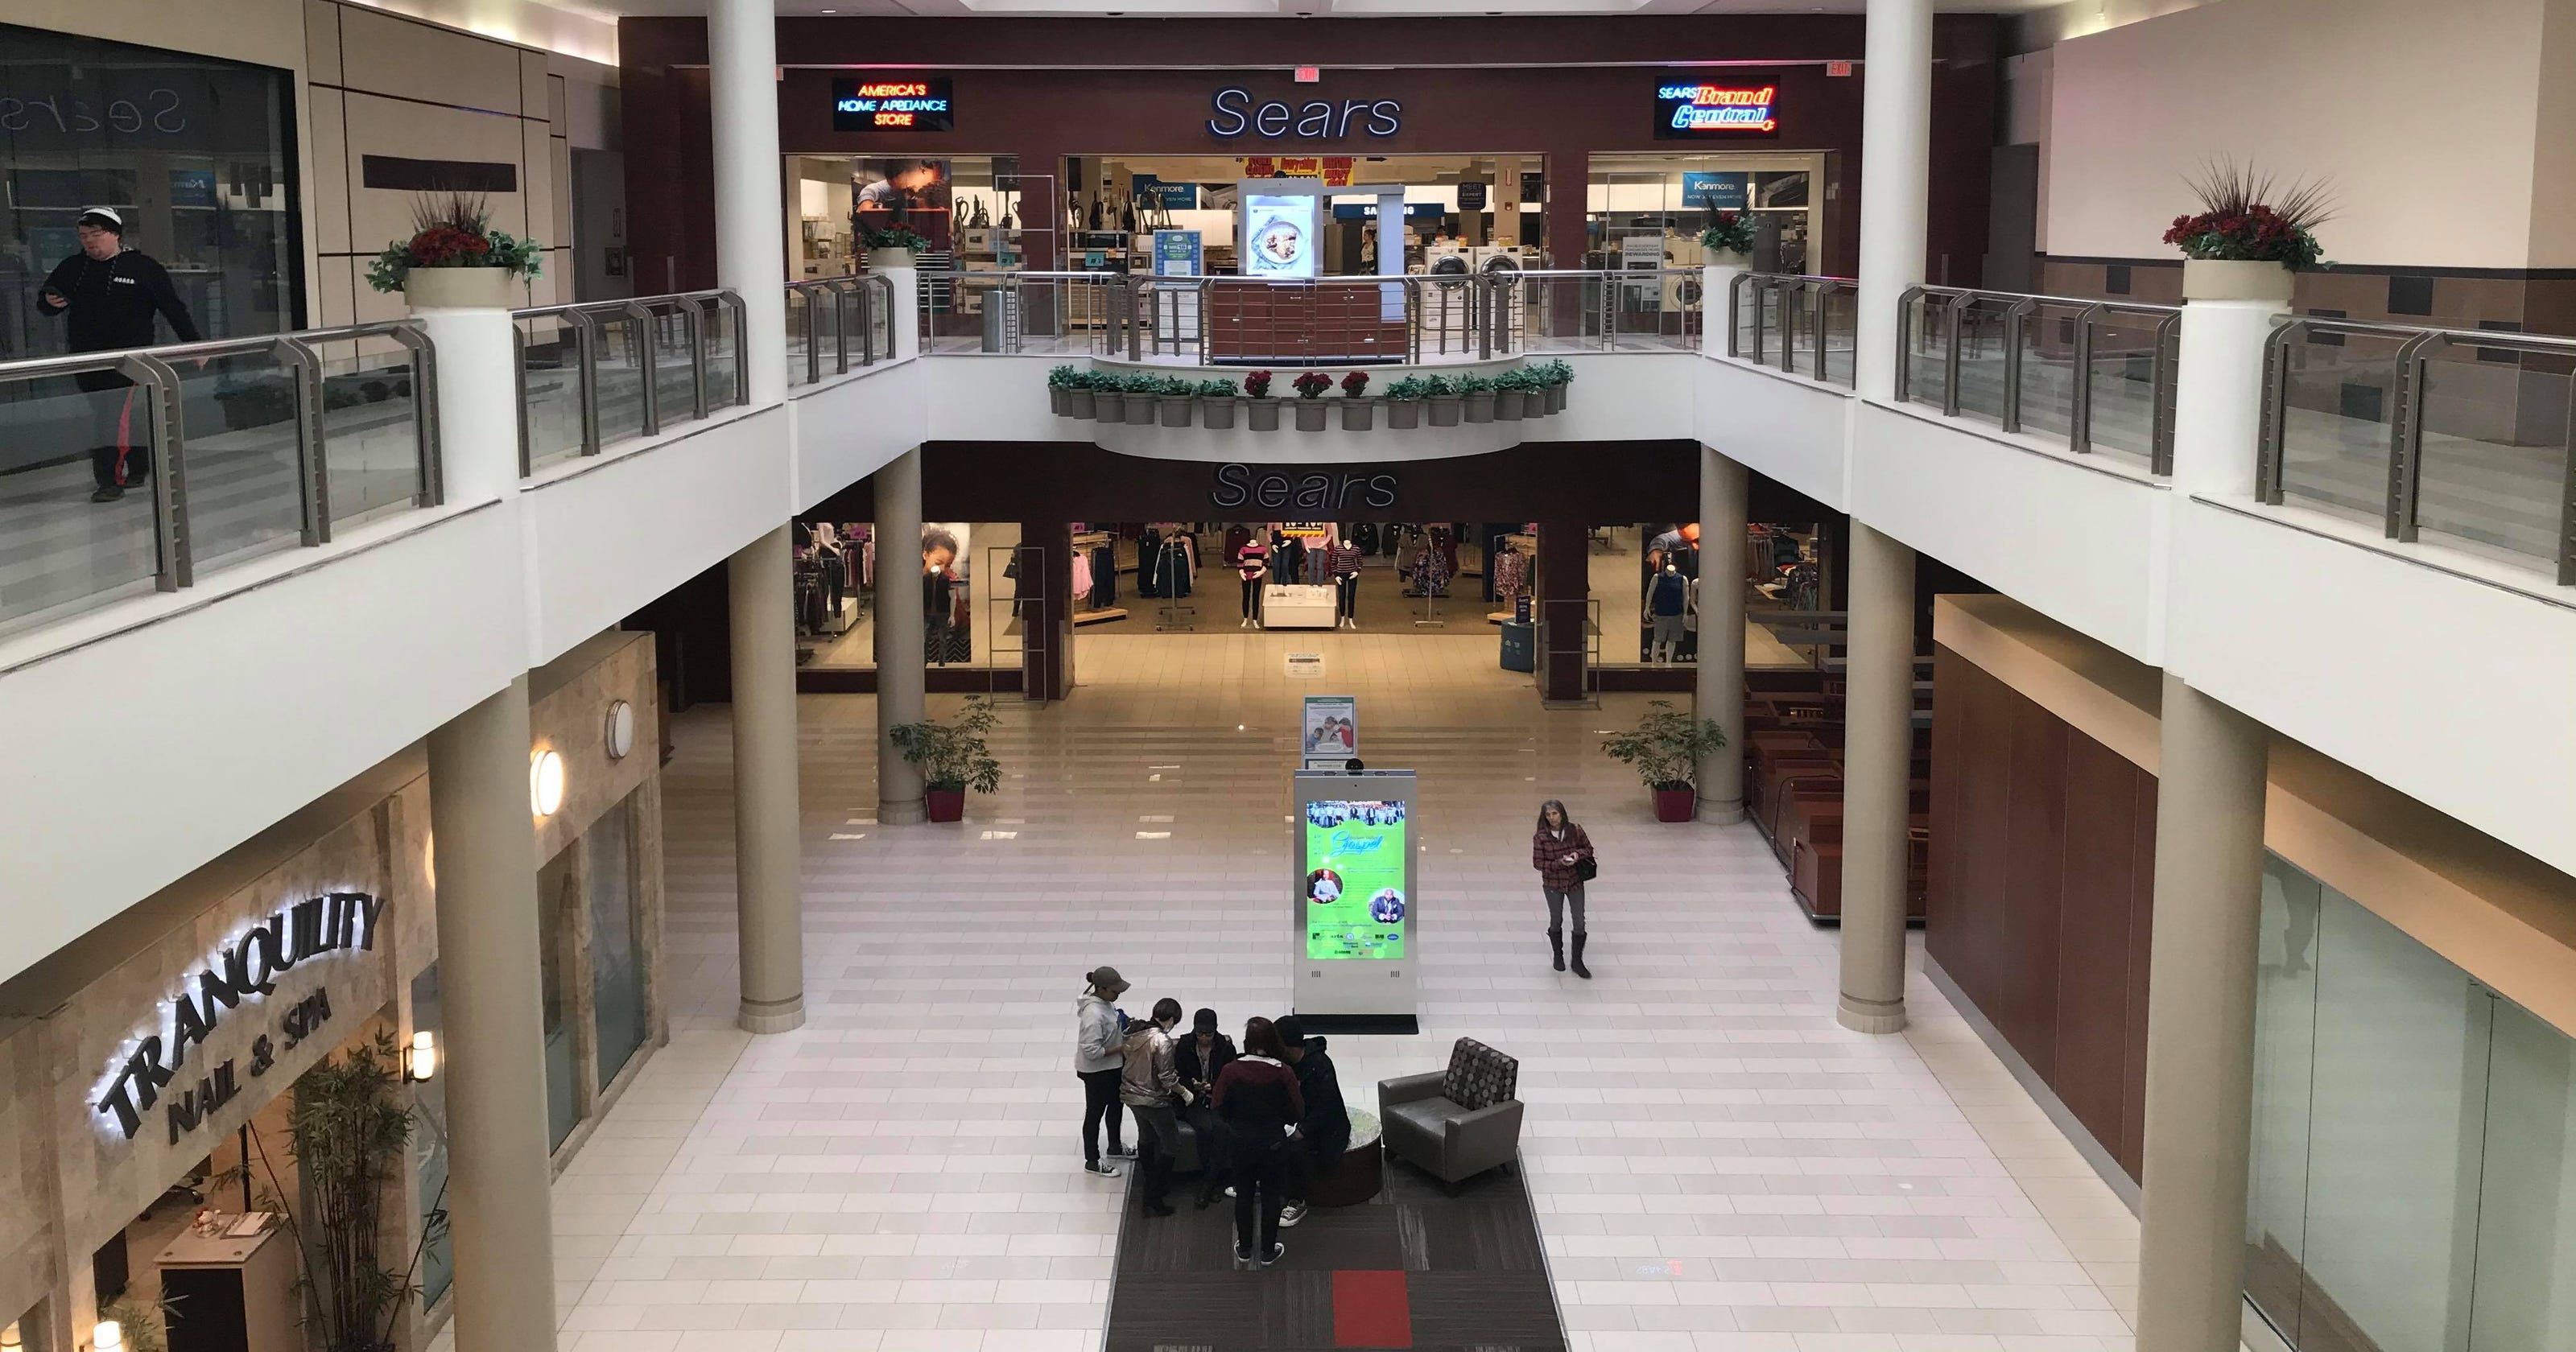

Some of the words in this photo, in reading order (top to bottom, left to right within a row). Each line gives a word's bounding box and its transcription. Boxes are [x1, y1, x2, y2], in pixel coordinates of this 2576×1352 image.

[1831, 63, 1851, 75] EXIT
[857, 84, 927, 97] AMERICA'S
[1658, 87, 1697, 99] SEARS
[1692, 86, 1773, 105] Brand
[838, 100, 877, 111] HOME
[880, 100, 947, 111] APPLIANCE
[1205, 85, 1404, 139] Sears
[874, 113, 913, 126] STORE
[1671, 105, 1767, 128] Central
[1144, 183, 1184, 193] Kenmore
[1694, 181, 1736, 190] Kenmore
[1210, 463, 1399, 509] Sears
[98, 892, 385, 1140] TRANQUILITY
[167, 1057, 242, 1145] NAIL
[250, 1033, 275, 1077] &
[283, 986, 332, 1050] SPA
